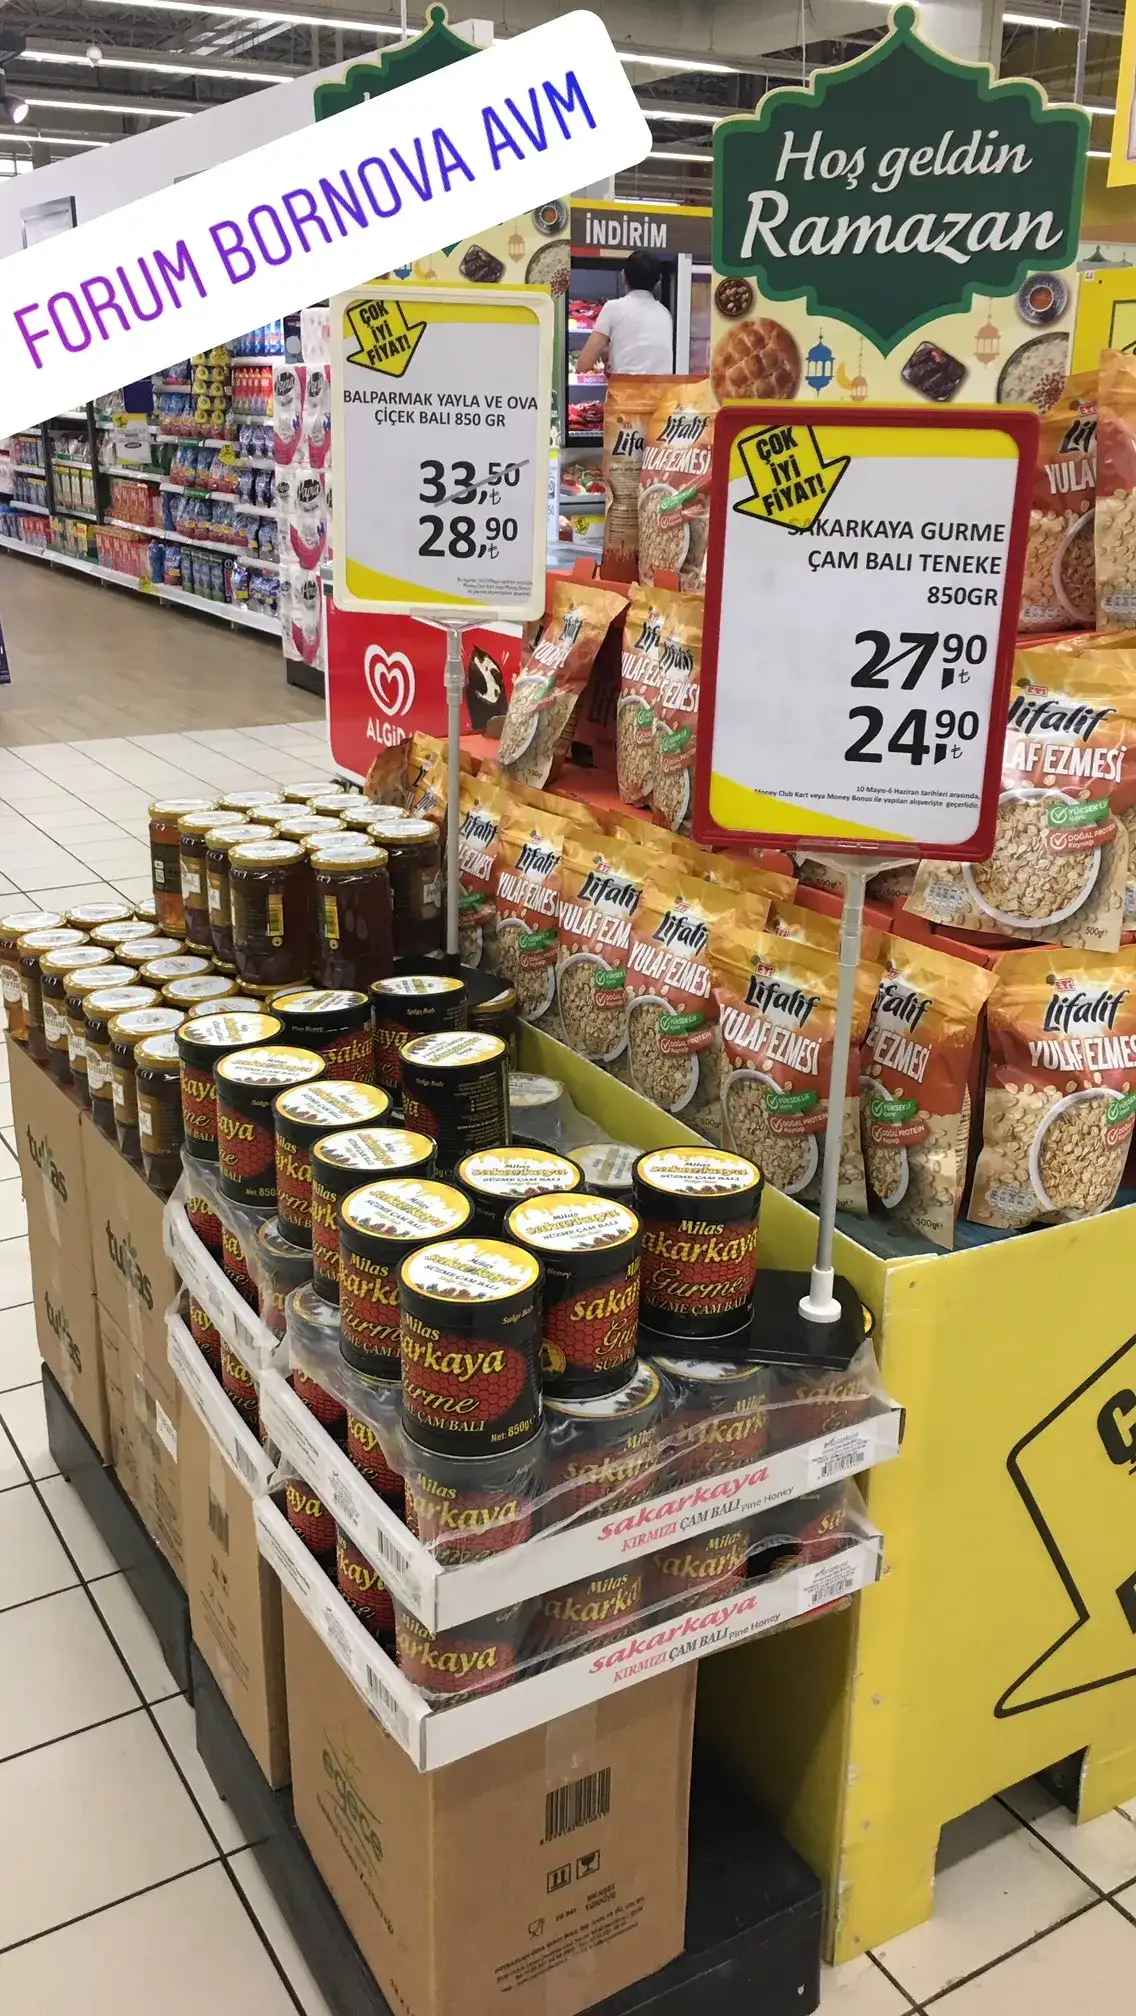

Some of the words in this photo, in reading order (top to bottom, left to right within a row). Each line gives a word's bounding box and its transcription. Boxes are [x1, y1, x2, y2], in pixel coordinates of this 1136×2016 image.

[775, 130, 866, 190] Hoş
[871, 129, 1033, 193] geldin
[585, 212, 667, 249] İNDİRİM
[740, 189, 1063, 264] Ramazan
[359, 300, 389, 325] ÇOK
[372, 321, 392, 342] İYİ
[367, 334, 412, 367] FİYAT!
[343, 390, 433, 407] BALPARMAK
[437, 393, 480, 408] YAYLA
[484, 395, 503, 409] VE
[507, 396, 538, 410] OVA
[374, 409, 415, 425] ÇİÇEK
[419, 410, 450, 425] BALI
[455, 412, 481, 427] 850
[485, 413, 506, 427] GR
[612, 431, 645, 458] Lifa
[756, 426, 799, 463] ÇOK
[770, 453, 801, 486] İYİ
[1045, 457, 1097, 494] YULA
[761, 473, 826, 517] FİYAT!
[920, 521, 1006, 543] GURME
[808, 550, 859, 573] ÇAM
[865, 552, 912, 572] BALI
[919, 554, 1002, 575] TENEKE
[927, 586, 998, 607] 850GR
[366, 716, 413, 747] ALGiD
[1006, 742, 1039, 773] LAF
[1044, 744, 1127, 783] EZMESİ
[856, 785, 865, 793] 10
[559, 901, 603, 938] YULAF
[599, 914, 632, 950] EZM
[627, 940, 671, 980] YULAF
[744, 976, 821, 1029] Lifalif
[872, 983, 933, 1033] falif
[1043, 989, 1130, 1034] Lifalif
[720, 1003, 773, 1052] YULAF
[765, 1025, 823, 1075] EZMESİ
[873, 1025, 932, 1084] EZMESİ
[1028, 1039, 1086, 1072] YULAF
[1083, 1035, 1136, 1071] EZMES
[259, 1187, 277, 1197] 850
[678, 1219, 725, 1236] Milas
[647, 1262, 747, 1299] Gurme
[341, 1296, 400, 1342] Gurm
[691, 1300, 724, 1318] ÇAM
[402, 1336, 505, 1383] arkaya
[449, 1417, 486, 1434] BALI
[597, 1465, 770, 1542] sakarkaya
[621, 1520, 679, 1553] KIRMIZI
[679, 1509, 711, 1532] ÇAM
[710, 1498, 741, 1521] BALI
[741, 1499, 763, 1513] Pine
[763, 1485, 795, 1504] Honey
[588, 1595, 758, 1675] sakarkaya
[612, 1650, 668, 1684] KIRMIZI
[668, 1639, 697, 1662] ÇAM
[697, 1626, 729, 1650] BALI
[728, 1626, 750, 1641] Pine
[749, 1611, 781, 1631] Honey
[399, 1639, 497, 1677] arkaya
